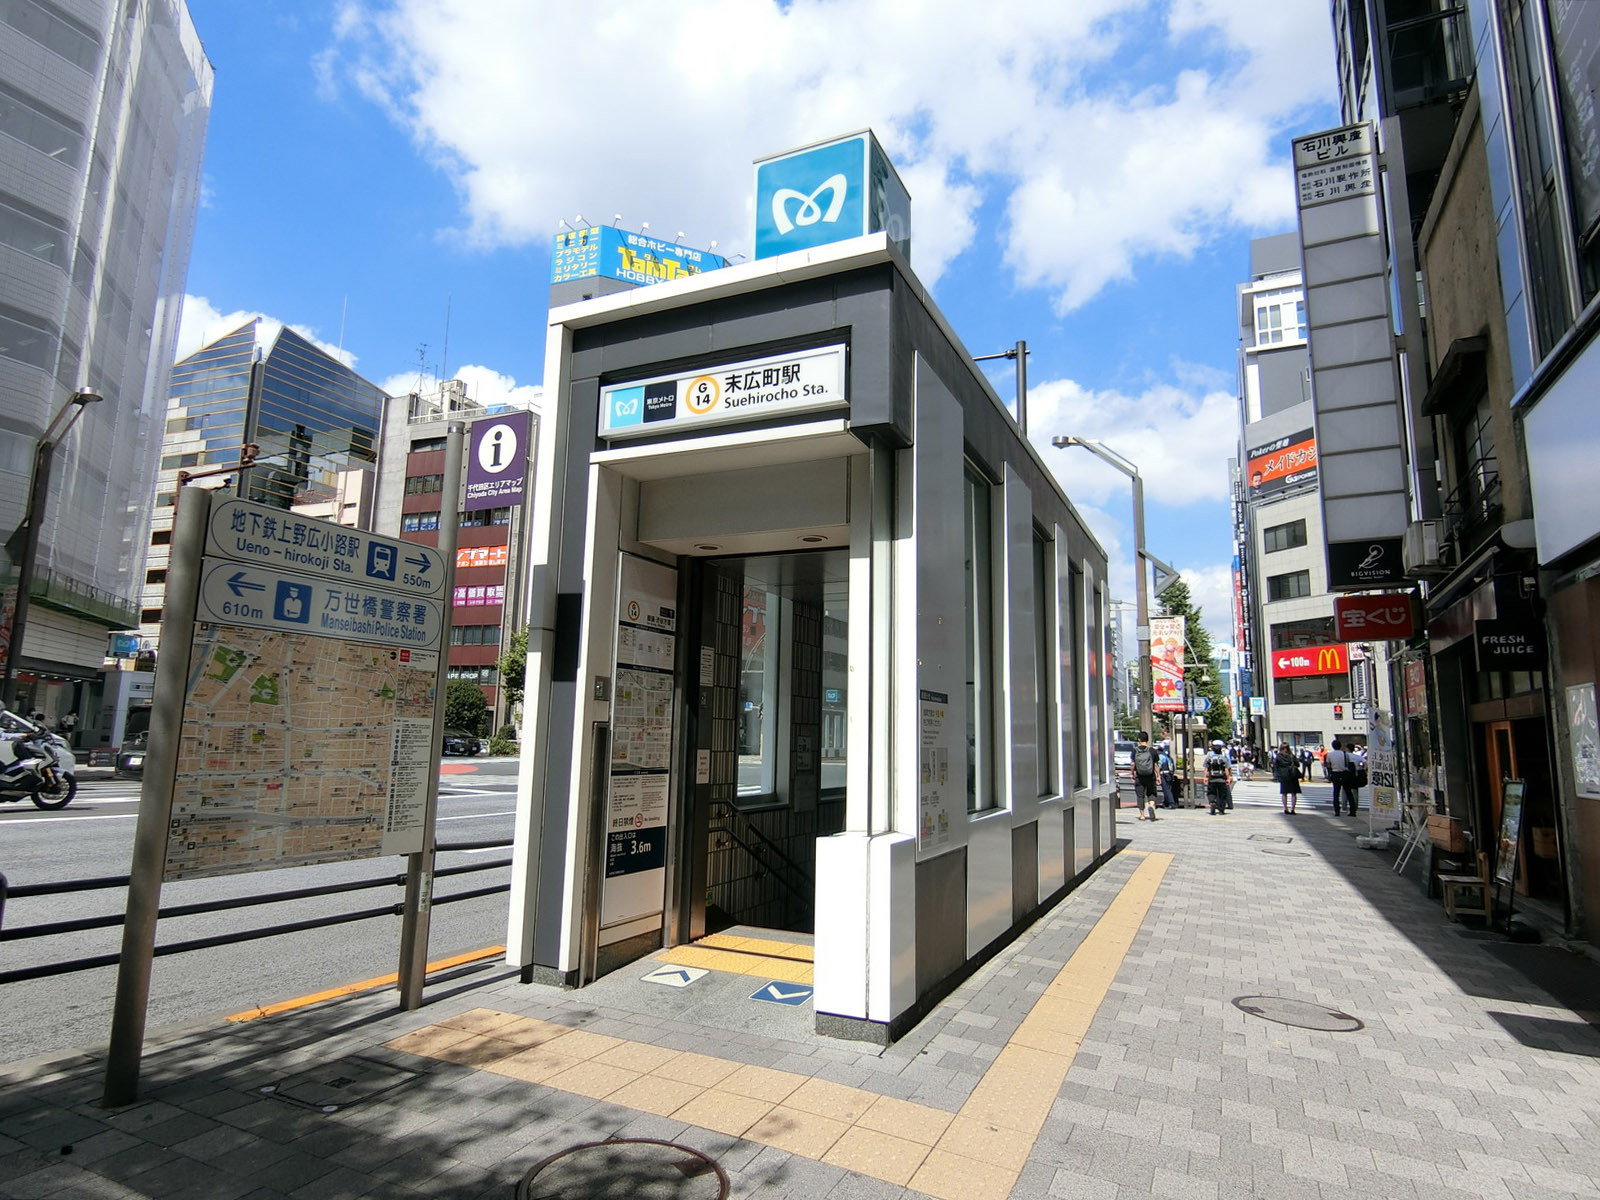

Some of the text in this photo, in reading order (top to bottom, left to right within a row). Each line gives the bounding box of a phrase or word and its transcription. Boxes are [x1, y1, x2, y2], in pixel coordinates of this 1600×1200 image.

[1317, 146, 1349, 160] ビル
[556, 244, 598, 258] プラモデル
[627, 234, 702, 262] 総合ホビー専門店
[555, 253, 598, 265] ラジコン
[617, 246, 701, 281] TamTa
[724, 364, 801, 393] 末広町駅
[646, 395, 675, 405] 東京メトロ
[695, 395, 711, 406] 14
[724, 384, 828, 409] Suehirocho Sta.
[467, 477, 523, 492] 千代田区エリアマップ
[467, 490, 488, 499] Chiyoda
[230, 508, 361, 559] 地下鉄上野広小路駅
[236, 537, 271, 557] Ueno
[284, 548, 329, 571] hirokoji
[333, 559, 354, 573] Sta.
[403, 573, 431, 589] 550m
[1350, 569, 1391, 578] BIGVISION
[223, 602, 263, 619] 610m
[324, 589, 427, 626] 万世橋警察署
[1341, 606, 1406, 628] 宝くじ
[321, 613, 427, 642] Manseibashi Police Station
[1482, 635, 1525, 645] FRESH
[1493, 645, 1535, 654] JUICE
[1290, 656, 1310, 667] 100m
[630, 840, 652, 855] 3.6m
